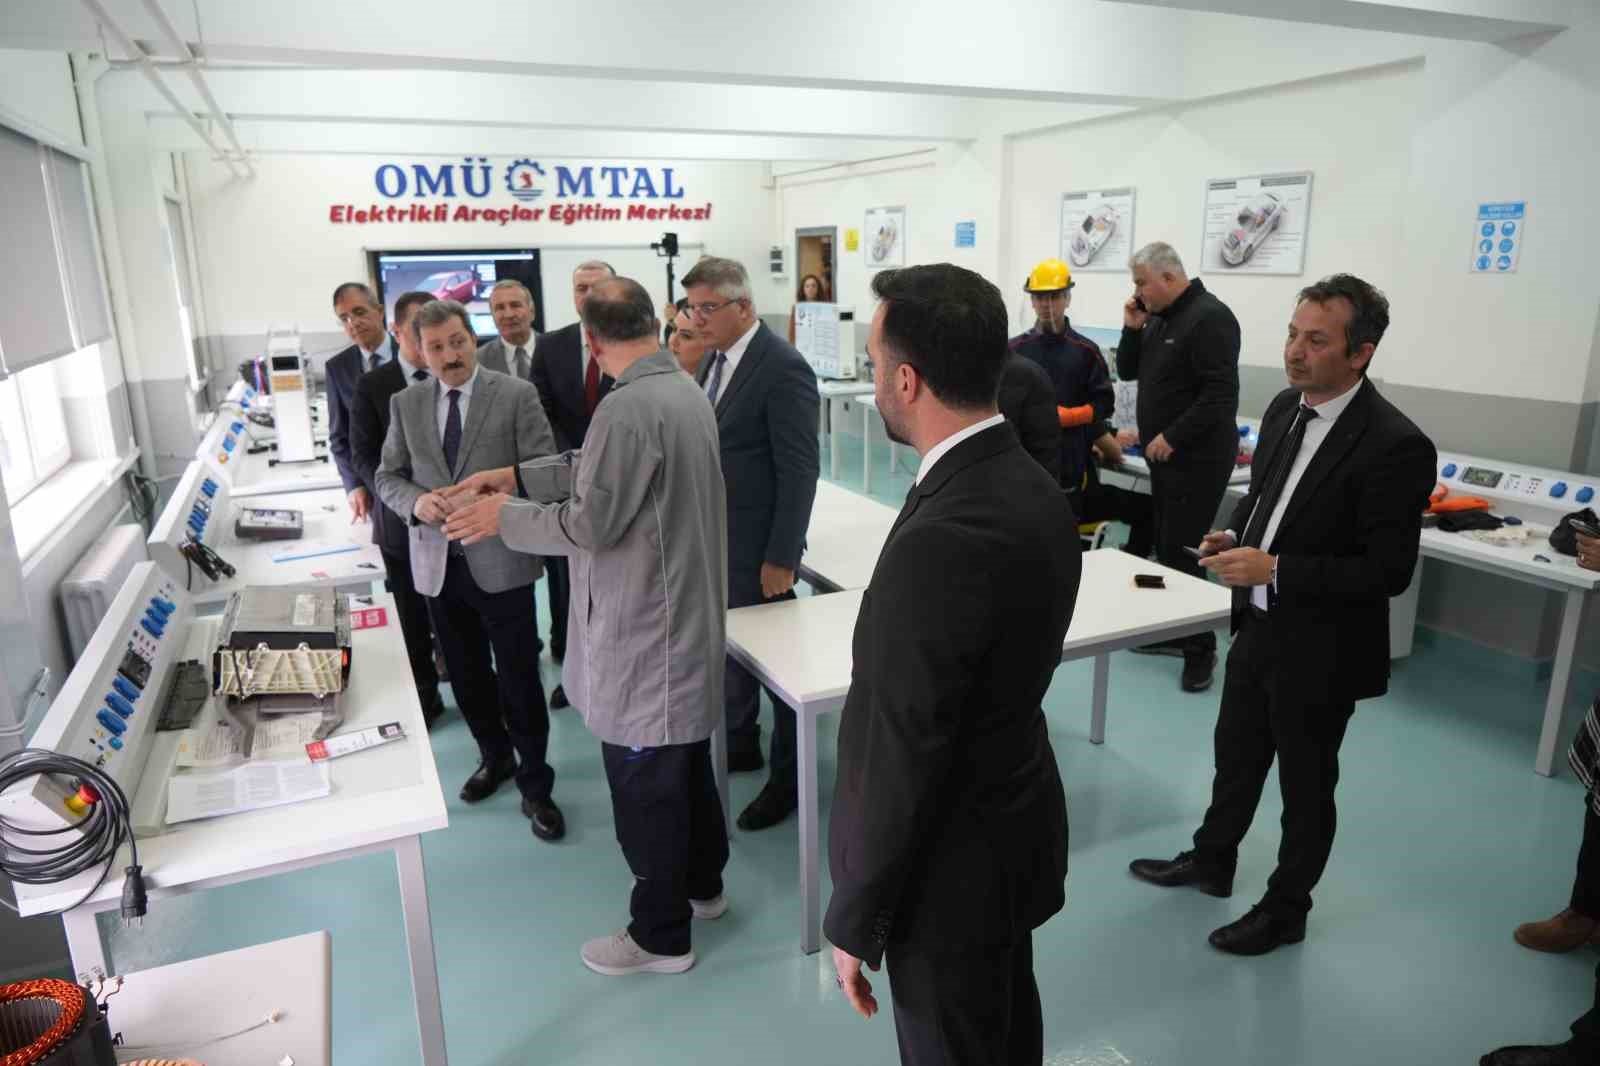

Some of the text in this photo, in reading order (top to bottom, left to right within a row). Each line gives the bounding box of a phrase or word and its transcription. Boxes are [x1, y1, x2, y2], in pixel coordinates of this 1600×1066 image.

[375, 157, 685, 199] OMÜ MTAL
[329, 203, 712, 226] Elektrikli Araçlar Eğitim Merkezi
